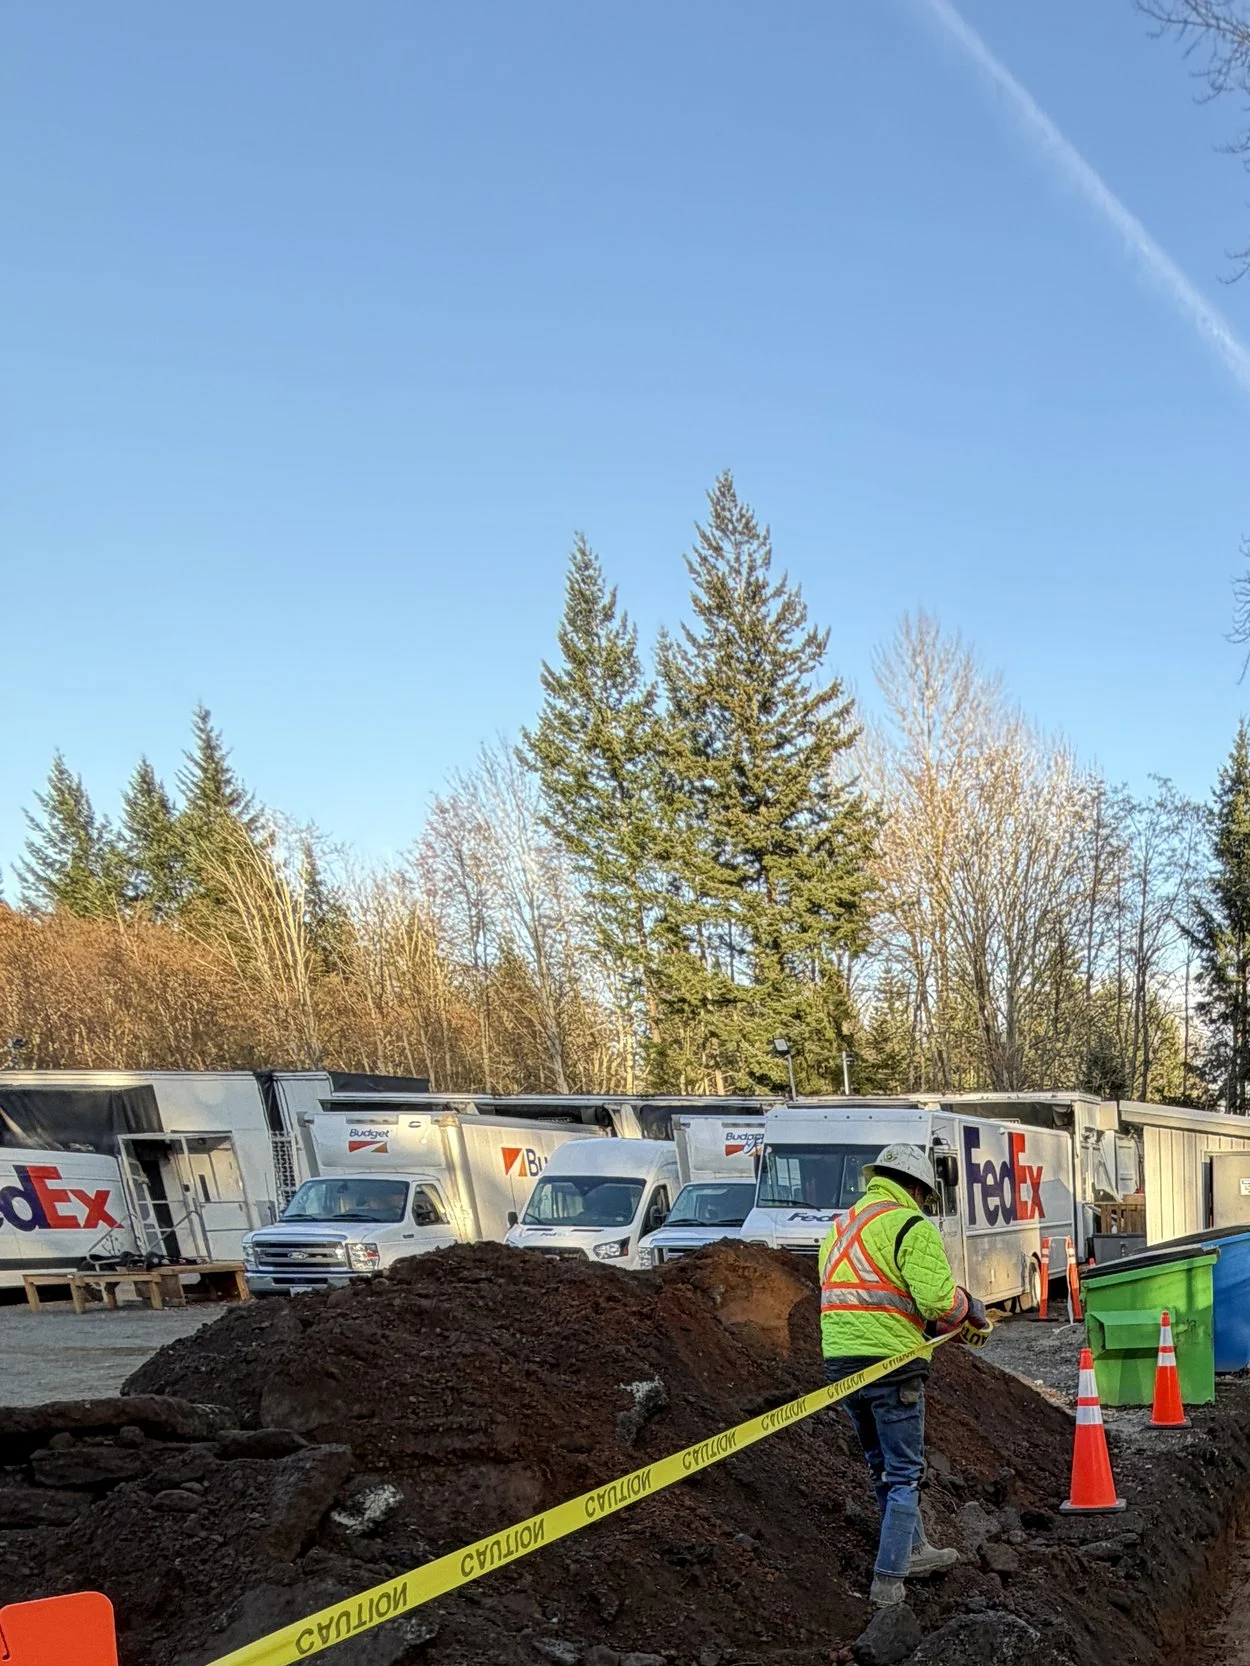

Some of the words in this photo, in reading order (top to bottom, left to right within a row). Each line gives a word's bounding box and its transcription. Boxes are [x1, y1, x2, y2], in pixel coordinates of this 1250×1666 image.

[349, 1128, 390, 1140] Budget
[963, 1125, 1046, 1227] FedEx
[0, 1164, 125, 1232] dEx
[786, 1212, 843, 1222] Fed
